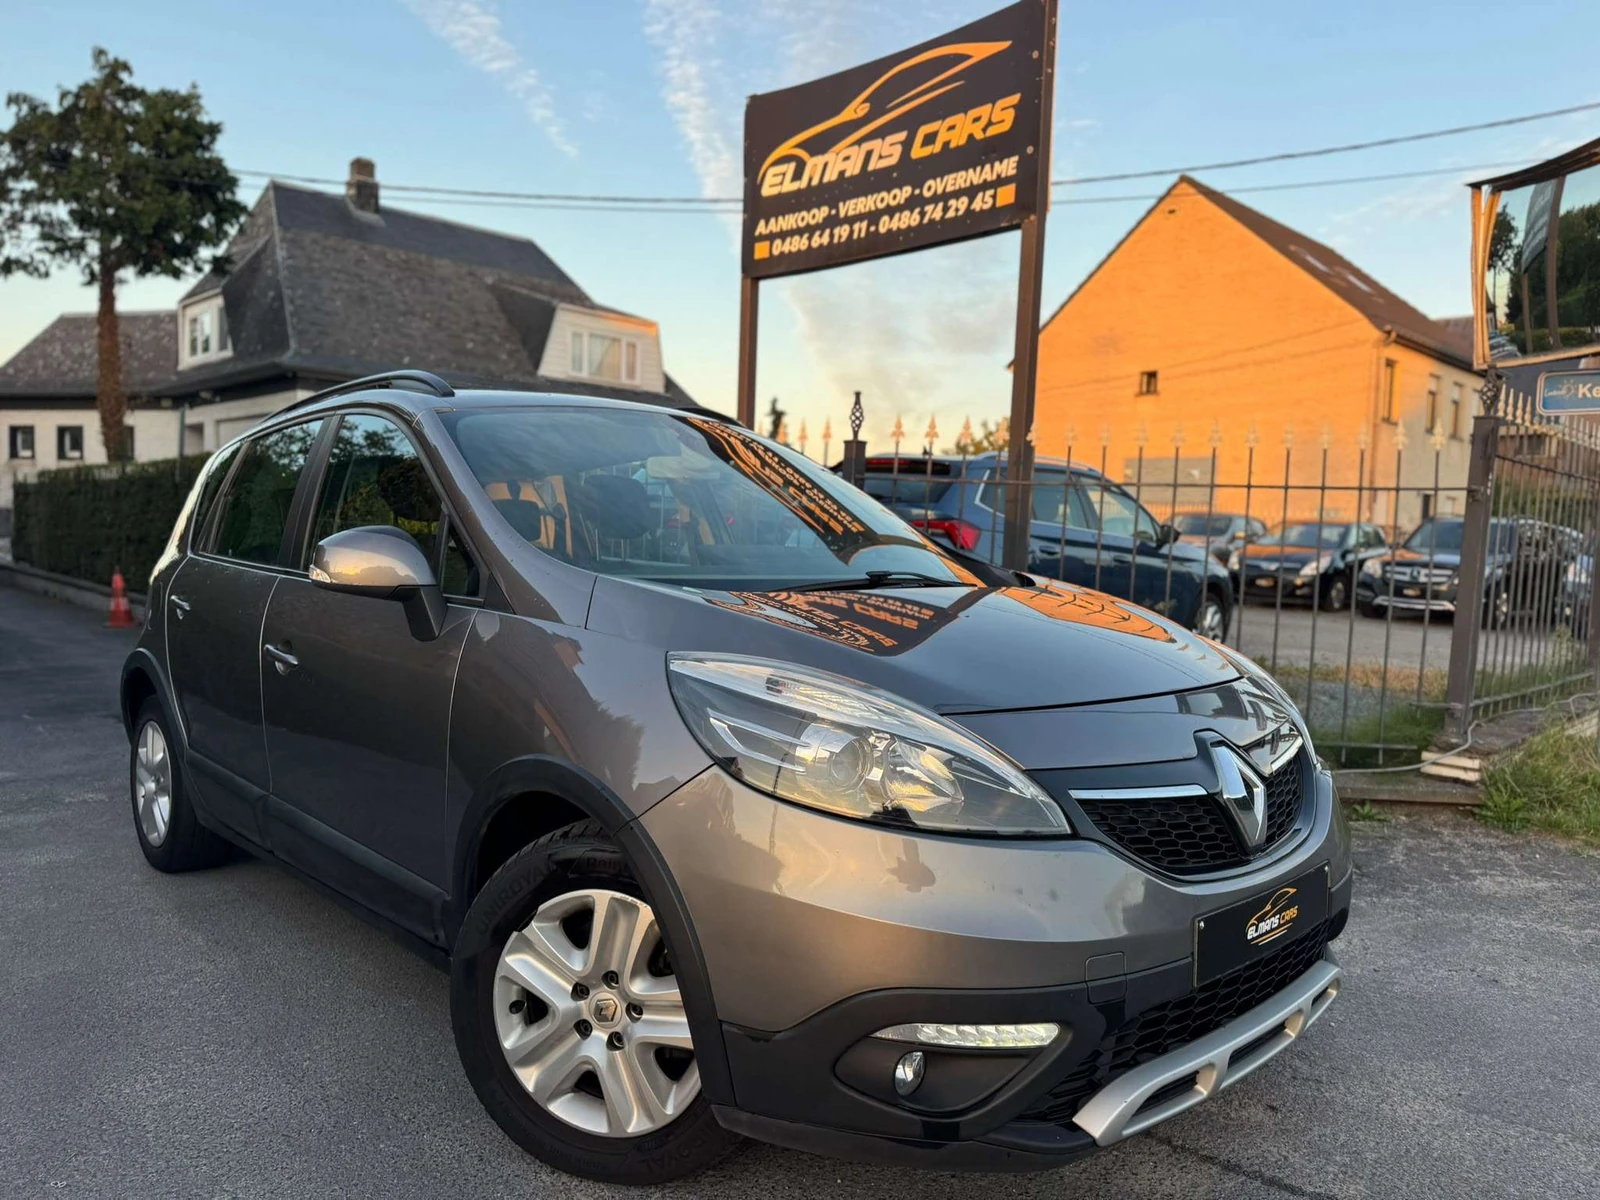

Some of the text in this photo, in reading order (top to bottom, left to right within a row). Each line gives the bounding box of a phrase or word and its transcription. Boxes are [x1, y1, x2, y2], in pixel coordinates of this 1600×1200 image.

[761, 93, 1022, 197] ELMANS CARS
[755, 205, 830, 237] AANKOOP
[839, 185, 912, 218] VERKOOP
[922, 155, 1019, 198] OVERNAME
[771, 233, 809, 257] 0486
[810, 228, 831, 249] 64
[832, 224, 850, 244] 19
[852, 220, 868, 240] 11
[878, 207, 921, 234] 0486
[922, 202, 944, 225] 74
[944, 196, 969, 220] 29
[970, 189, 996, 212] 45
[1247, 905, 1298, 940] ELMANS CARS
